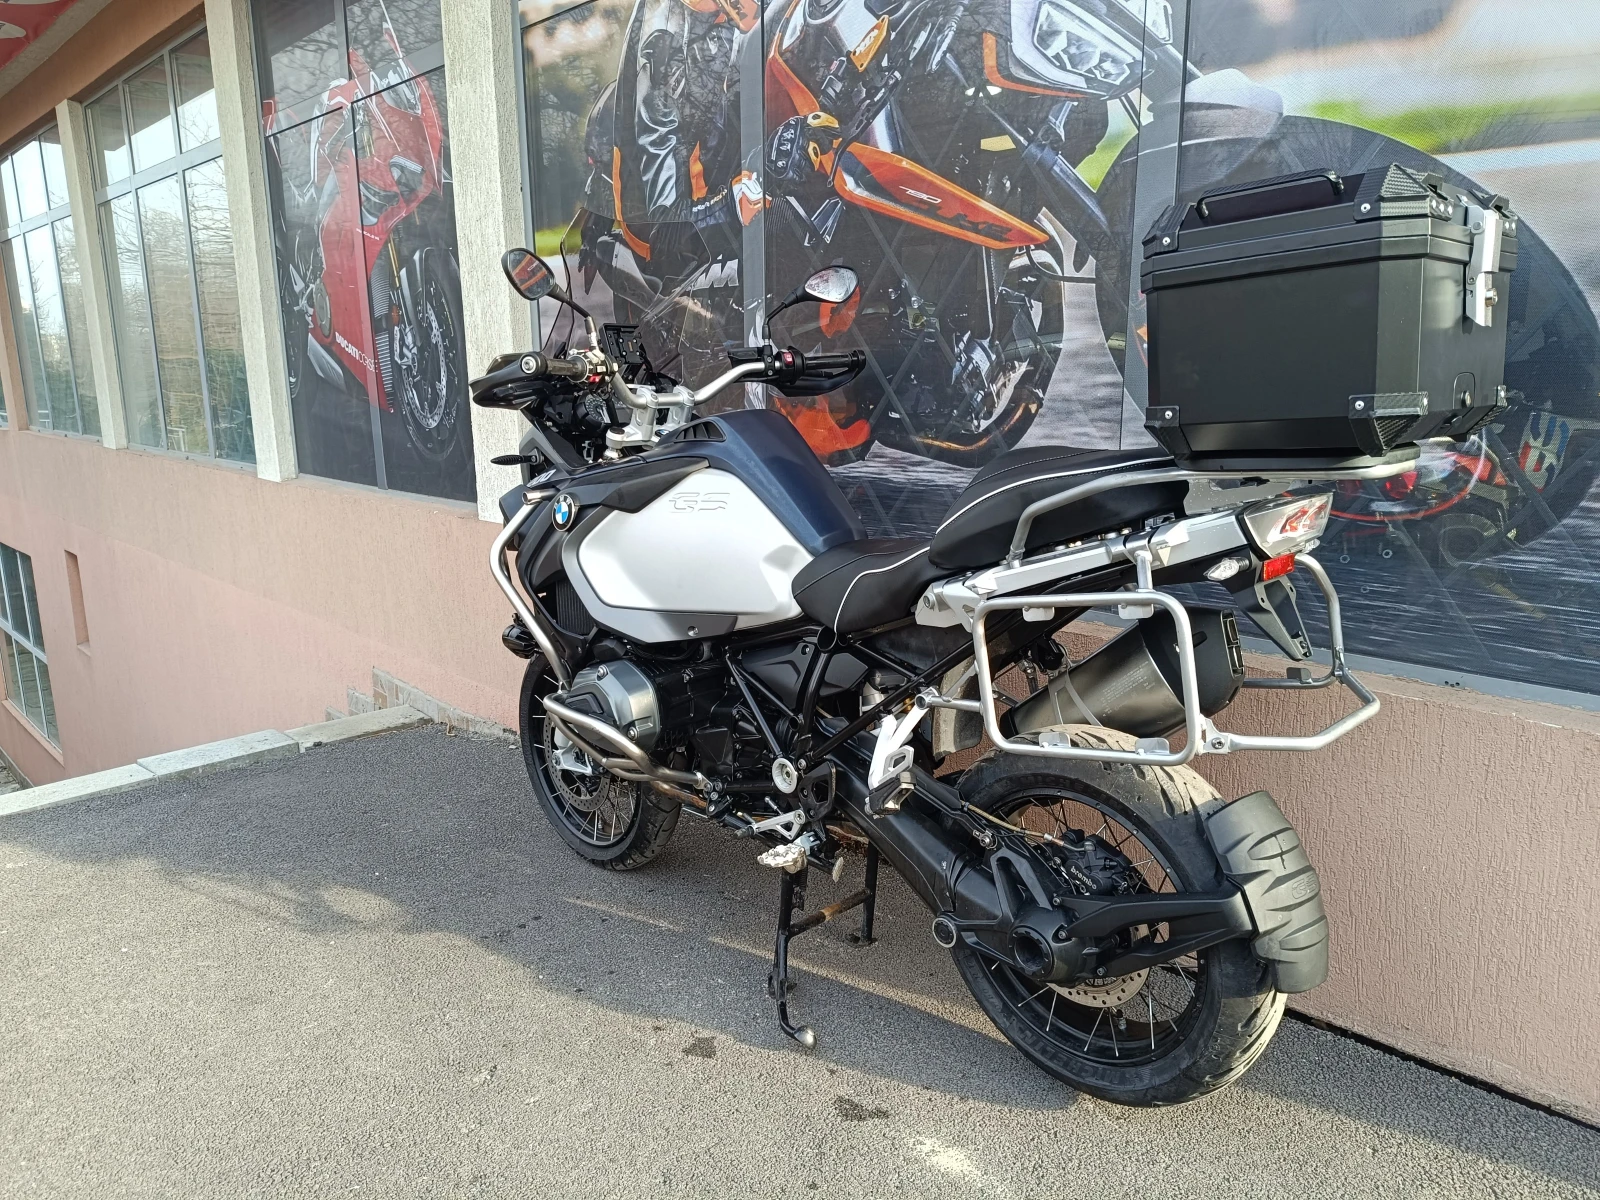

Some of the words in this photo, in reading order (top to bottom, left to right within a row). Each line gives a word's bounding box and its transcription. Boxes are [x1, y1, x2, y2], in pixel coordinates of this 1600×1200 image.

[335, 331, 359, 361] DUCATI
[668, 491, 731, 514] GS
[1070, 865, 1097, 890] brembo
[1291, 871, 1318, 900] GS
[1017, 1025, 1122, 1086] MICHELIN
